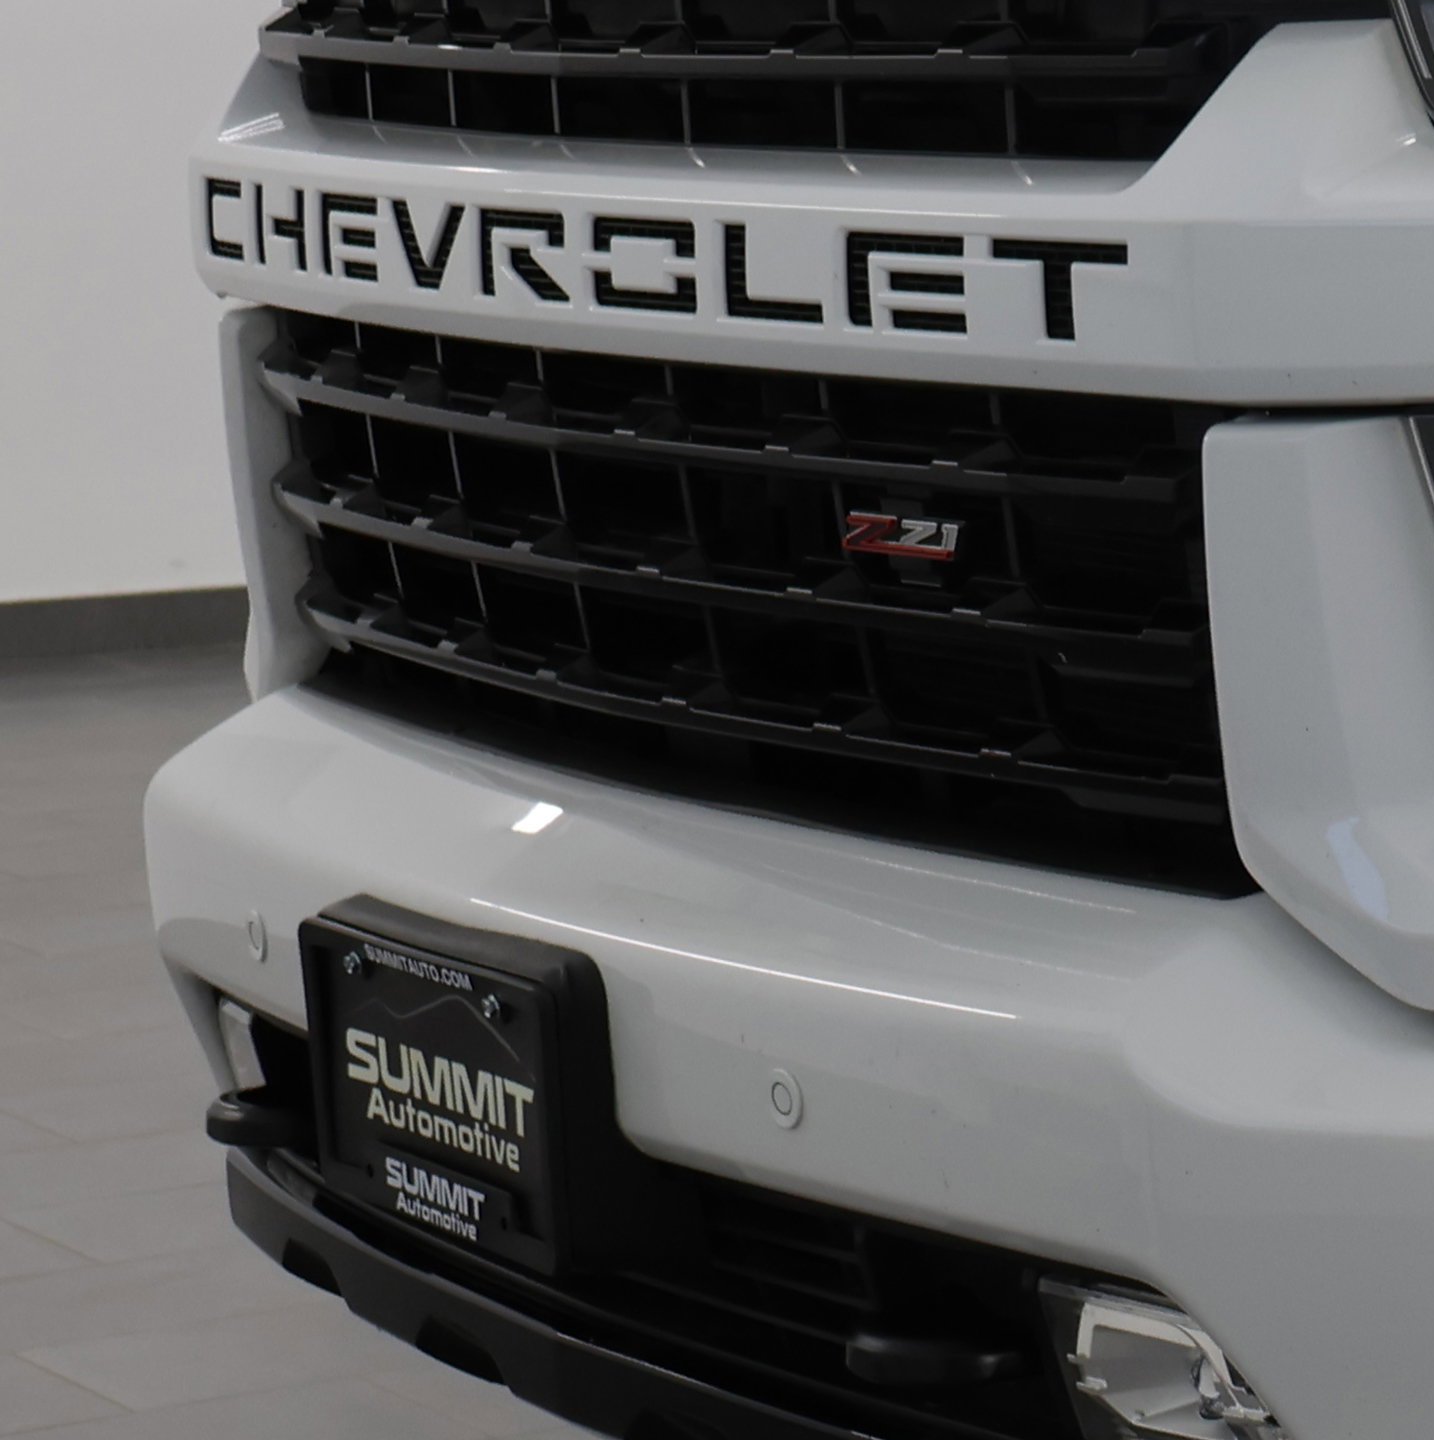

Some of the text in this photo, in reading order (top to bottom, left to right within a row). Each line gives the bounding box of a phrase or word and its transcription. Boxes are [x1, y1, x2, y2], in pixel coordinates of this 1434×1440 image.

[205, 176, 1128, 341] CHEVROLET
[844, 511, 956, 560] Z71
[364, 943, 473, 991] SUMMITAUTO.COM
[346, 1027, 534, 1137] SUMMIT
[367, 1087, 520, 1172] Automotive
[386, 1156, 485, 1221] SUMMIT
[396, 1191, 477, 1241] Automotive
